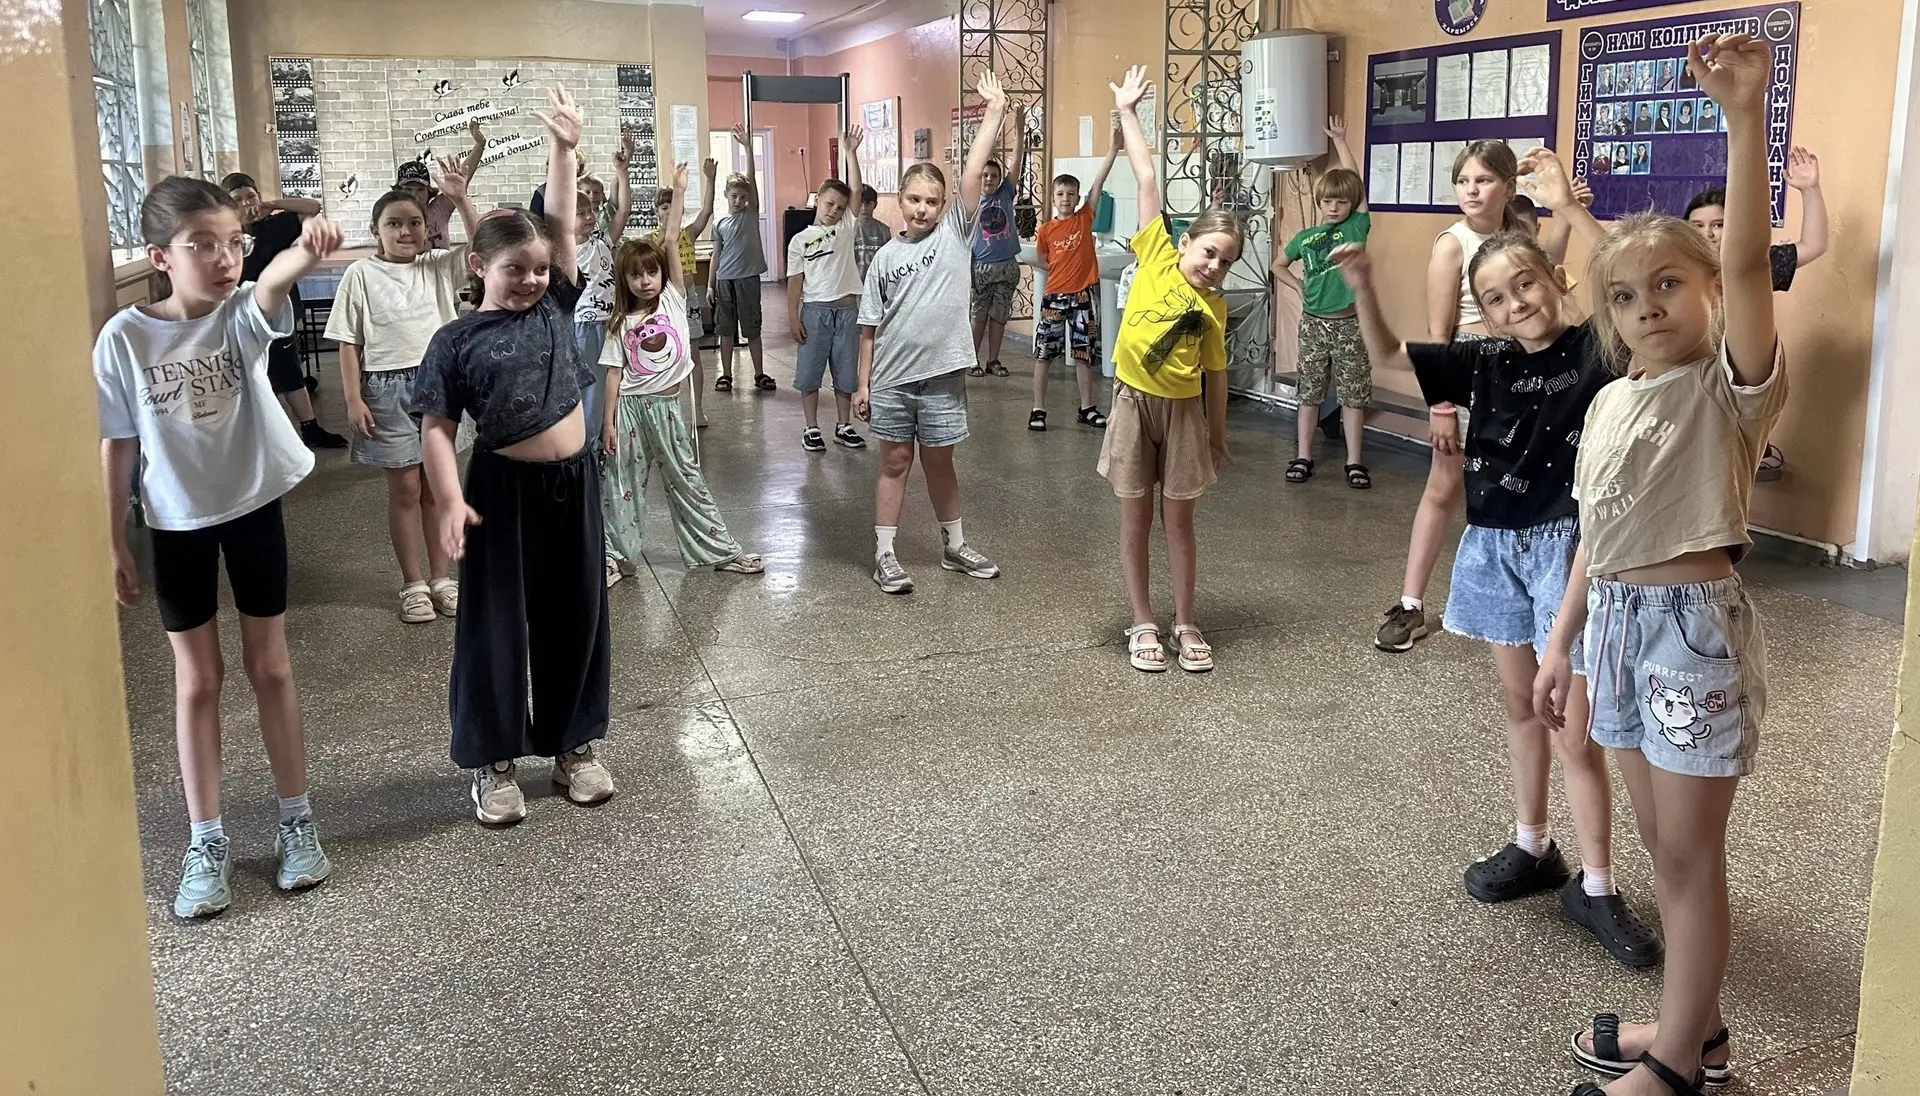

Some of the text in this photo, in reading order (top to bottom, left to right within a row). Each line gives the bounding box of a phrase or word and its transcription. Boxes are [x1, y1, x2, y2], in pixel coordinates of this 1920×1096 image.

[1605, 32, 1645, 53] НАШ
[1650, 17, 1760, 47] КОЛЛЕКТИВ
[434, 98, 490, 123] Слава тебе
[1576, 63, 1594, 177] ГИМНАЗ
[414, 105, 520, 144] Советская Отчизна!
[1768, 43, 1791, 222] ДОМИНАНТА
[488, 132, 521, 149] Сыны
[507, 136, 545, 156] дошли!
[142, 350, 232, 386] TENNIS
[139, 381, 183, 406] Court
[1642, 660, 1703, 683] PURRFECT
[1707, 700, 1724, 709] OW
[1708, 693, 1723, 701] ME
